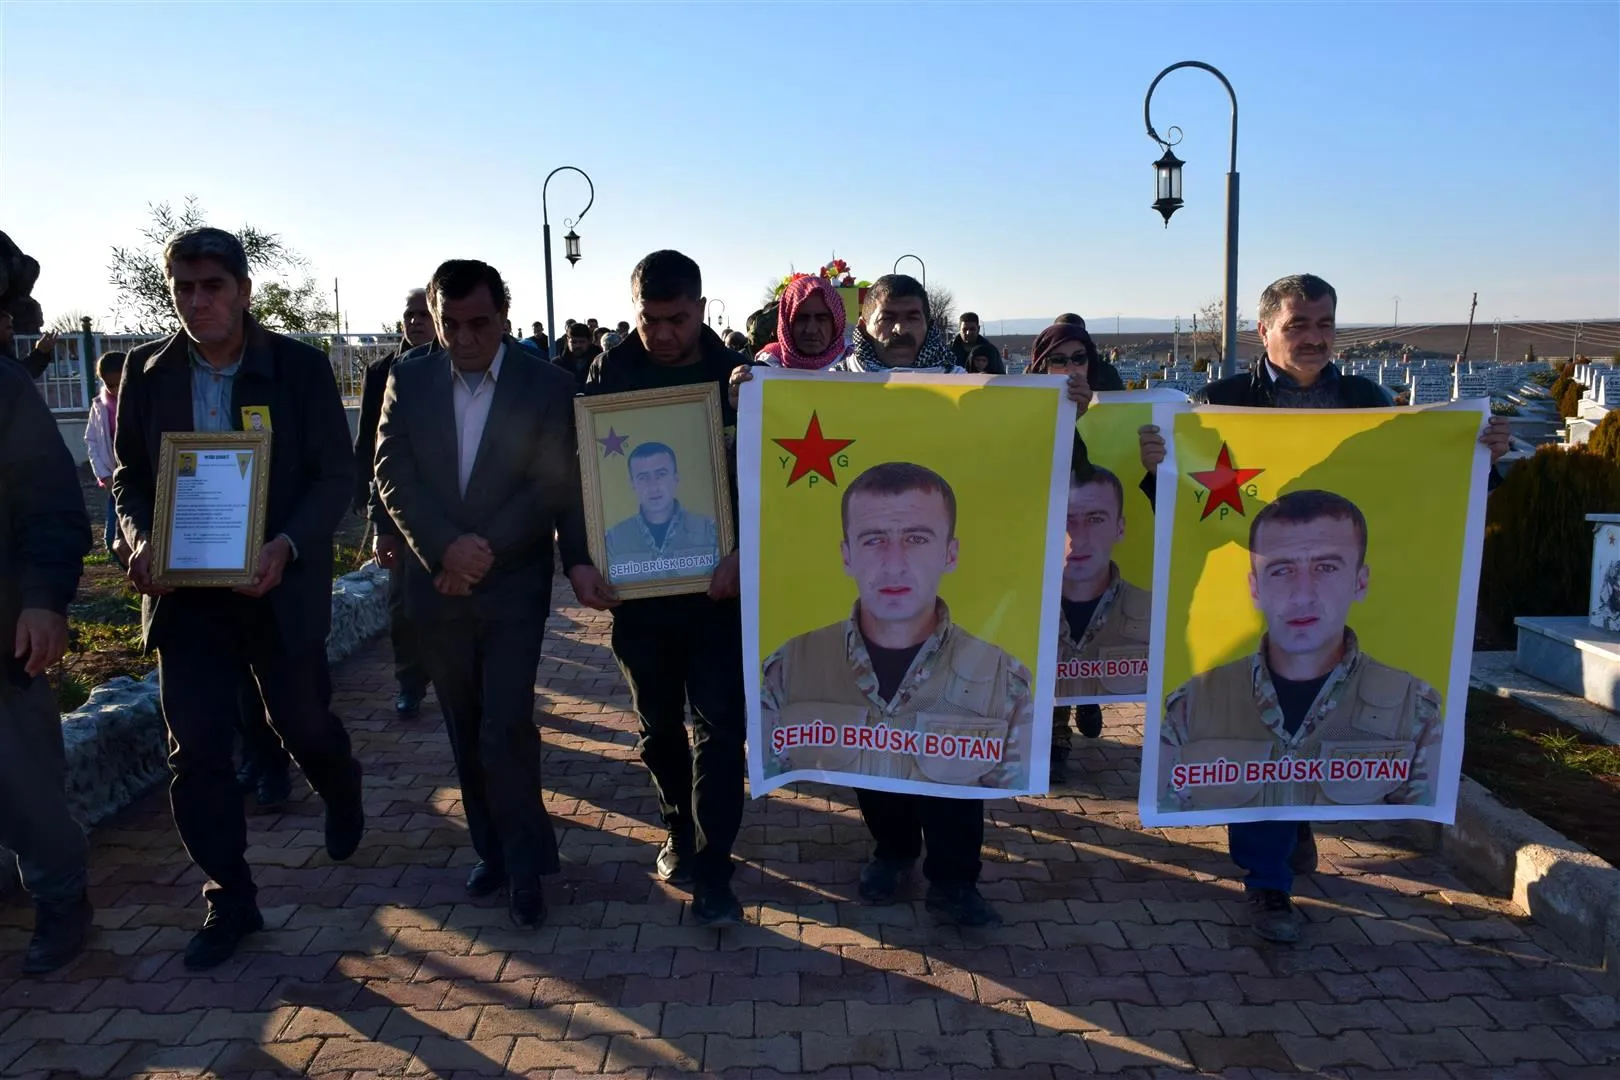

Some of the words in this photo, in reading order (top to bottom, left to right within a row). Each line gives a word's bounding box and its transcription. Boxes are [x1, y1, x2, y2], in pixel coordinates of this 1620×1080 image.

[679, 555, 713, 568] BOTAN
[1056, 659, 1102, 678] RÛSK
[1106, 660, 1149, 675] BOTA
[773, 721, 836, 752] ŞEHÎD
[843, 724, 918, 752] BRÛSK
[925, 735, 1001, 760] BOTAN
[1173, 759, 1239, 789] ŞEHÎD
[1246, 757, 1325, 782] BRÛSK
[1330, 760, 1409, 780] BOTAN
